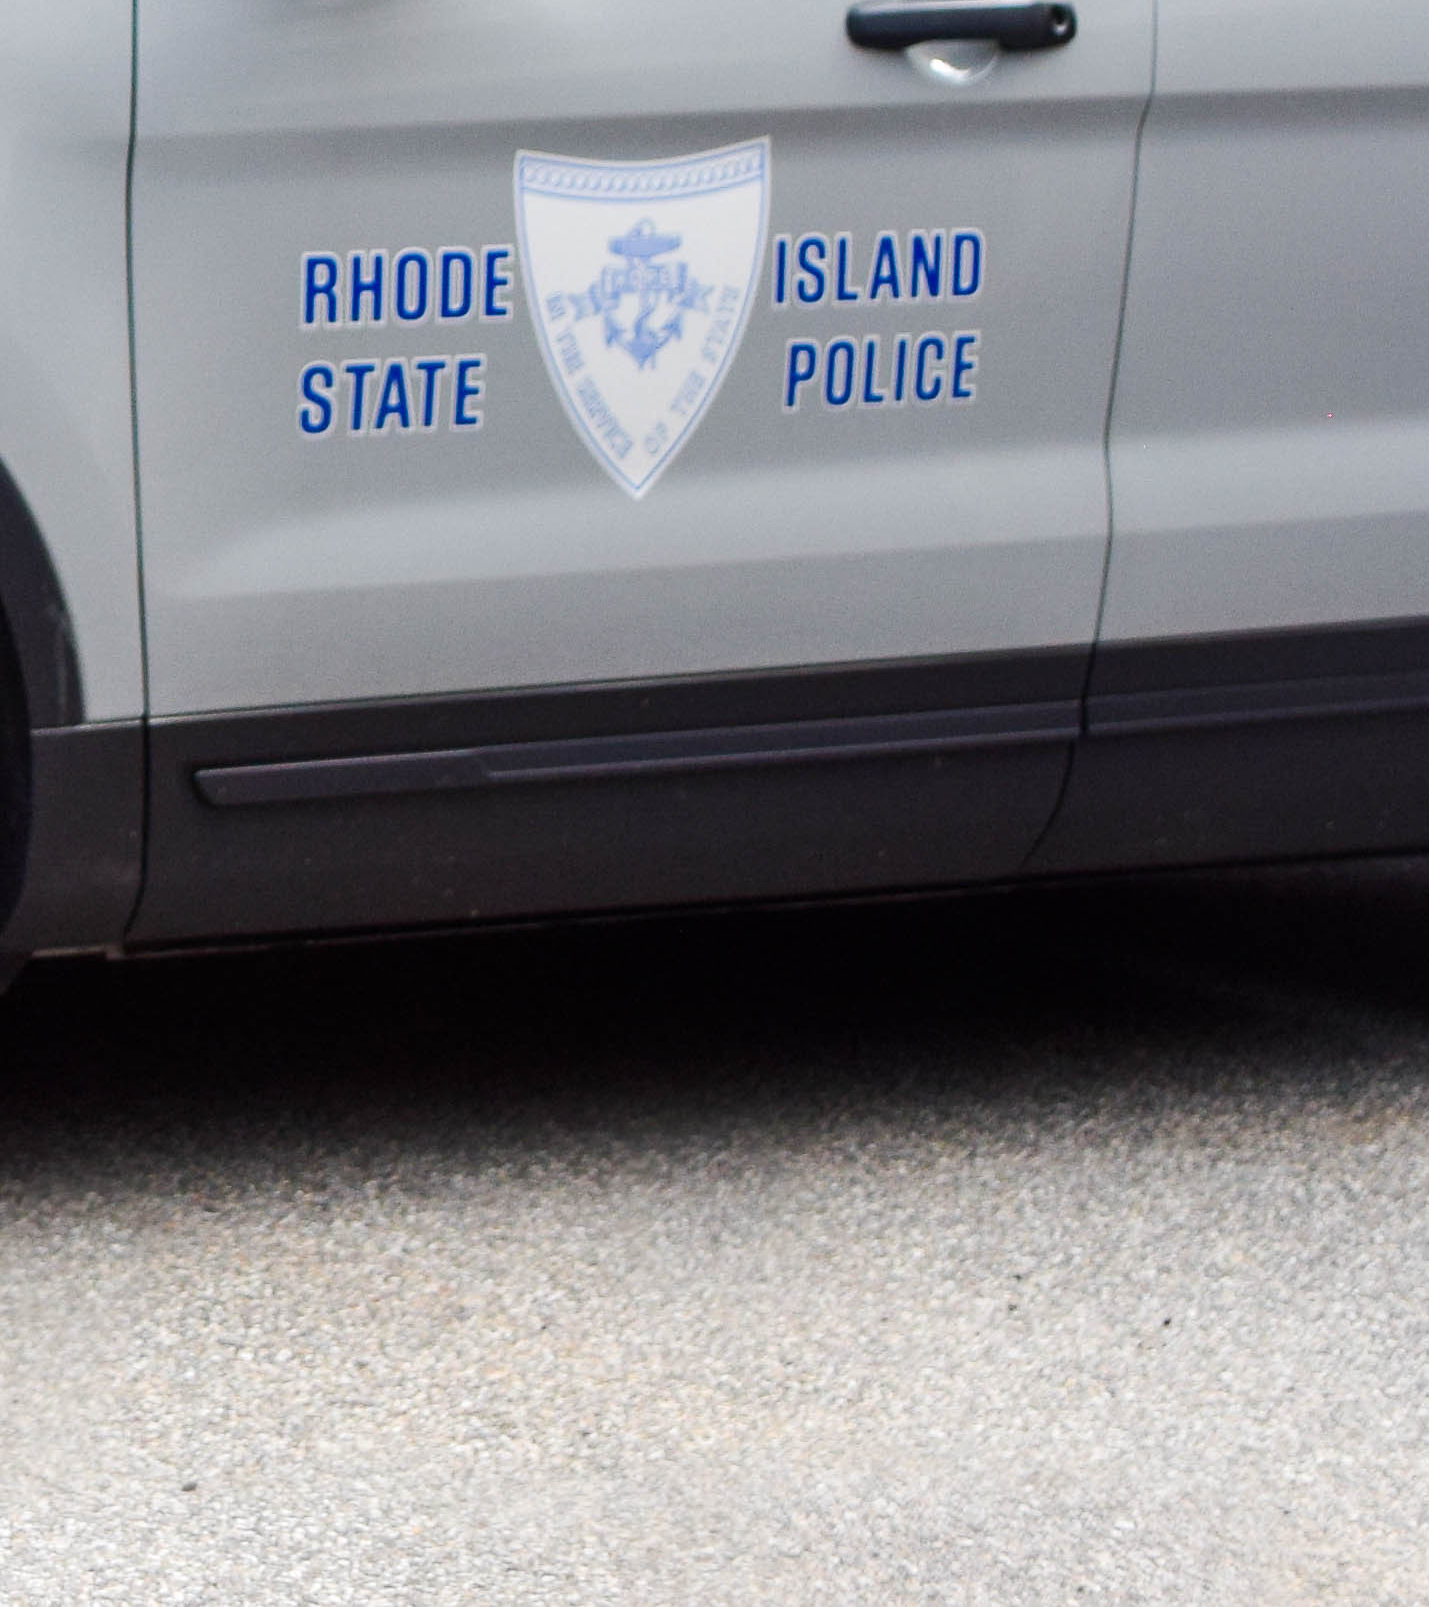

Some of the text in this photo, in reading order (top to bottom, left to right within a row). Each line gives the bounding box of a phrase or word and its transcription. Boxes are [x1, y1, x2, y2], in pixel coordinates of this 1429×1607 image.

[302, 231, 983, 326] RHODE ISLAND
[298, 333, 978, 436] STATE POLICE
